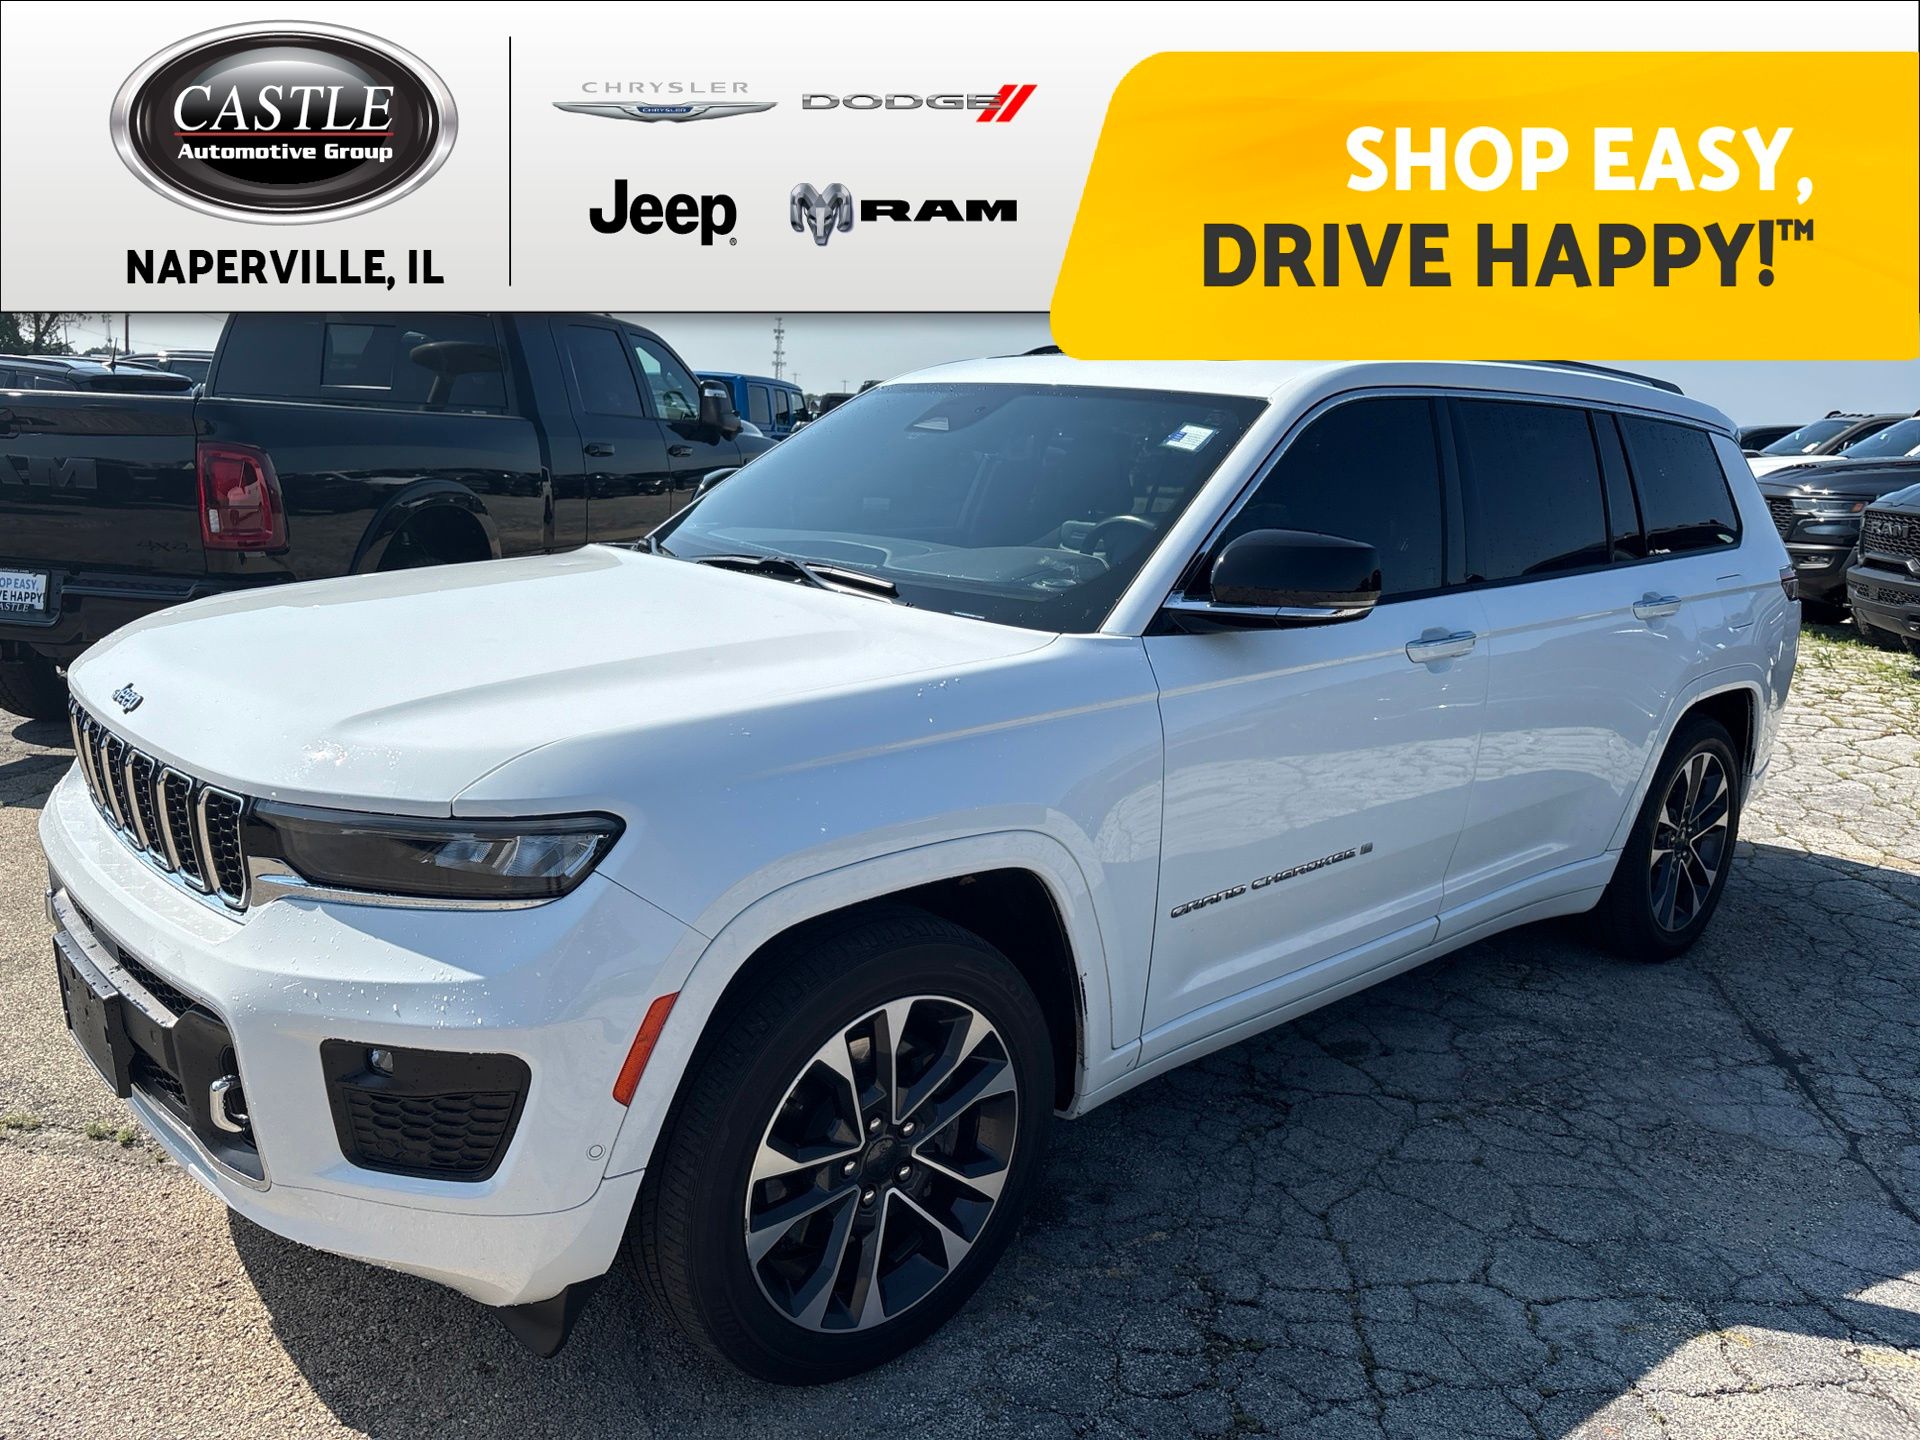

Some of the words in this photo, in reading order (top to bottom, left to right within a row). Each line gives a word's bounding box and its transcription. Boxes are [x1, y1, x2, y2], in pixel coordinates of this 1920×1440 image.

[1871, 520, 1910, 539] RAM
[111, 682, 144, 715] Jeep
[1171, 884, 1248, 918] GRAND
[1251, 847, 1357, 890] CHEROKEE
